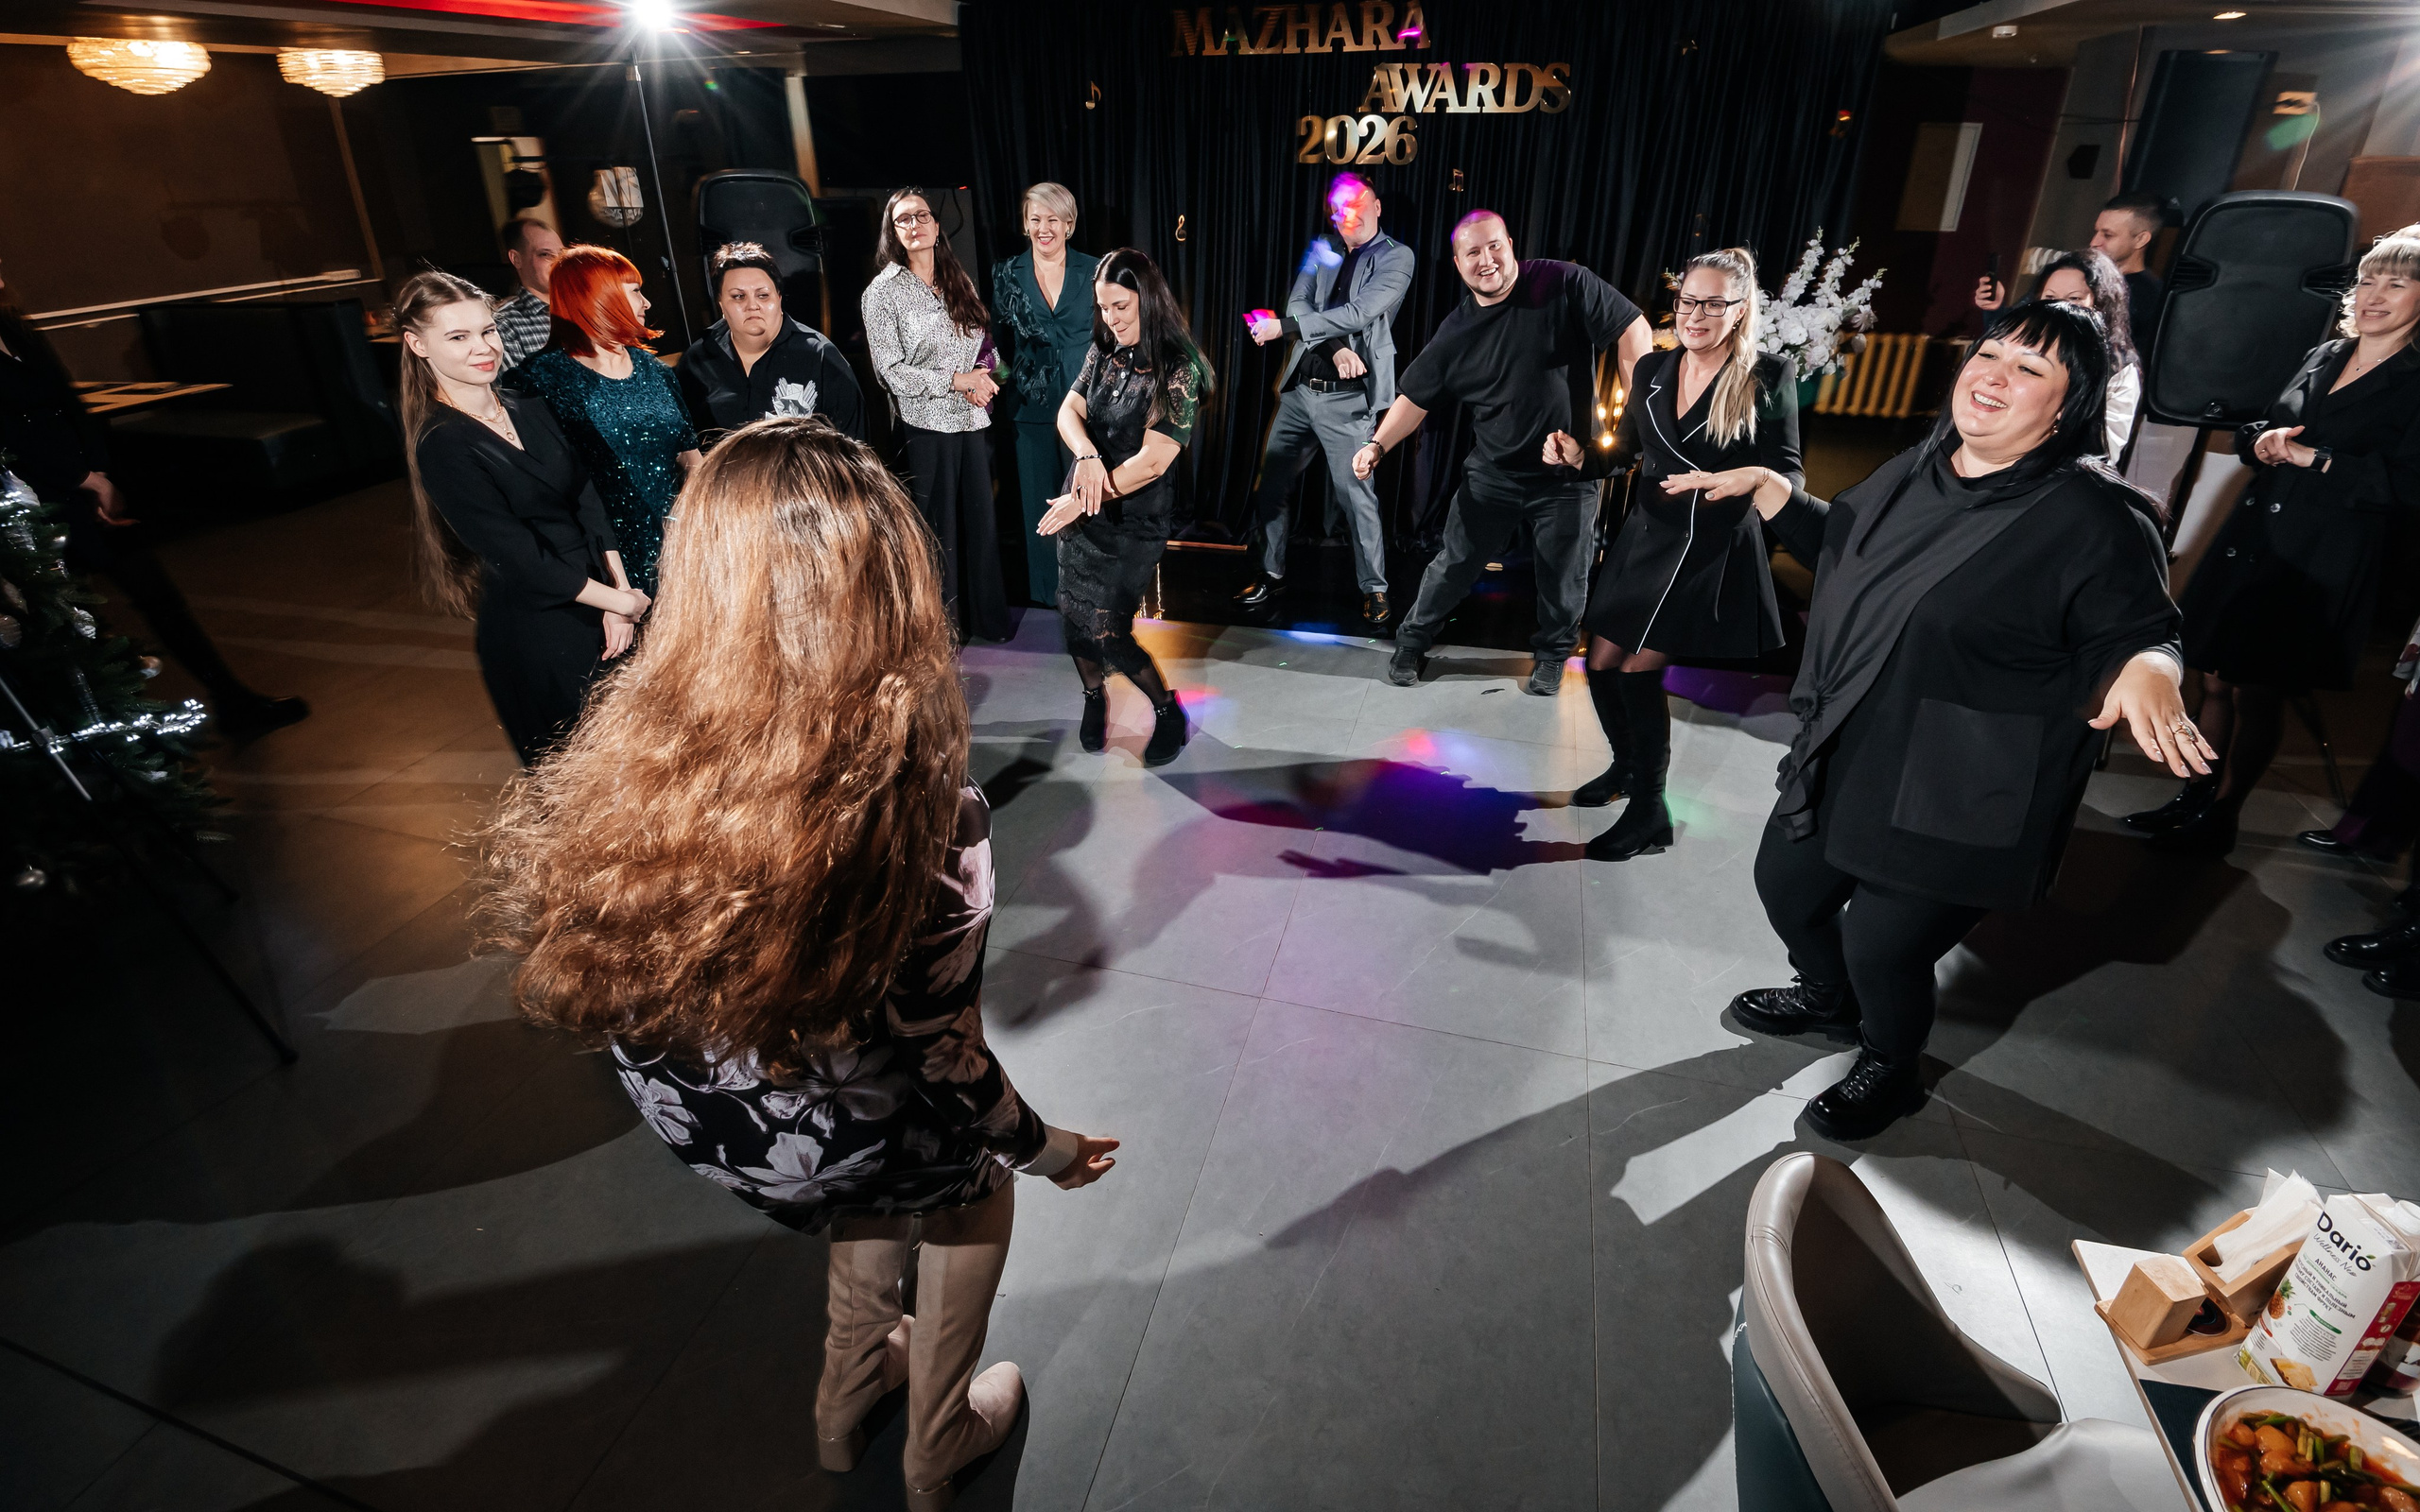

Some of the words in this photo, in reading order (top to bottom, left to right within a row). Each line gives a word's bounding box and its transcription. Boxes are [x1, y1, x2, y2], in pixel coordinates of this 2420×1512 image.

[1170, 0, 1430, 57] MAZHARA
[1356, 61, 1571, 113] AWARDS
[1297, 114, 1418, 165] 2026
[2313, 1232, 2342, 1263] Wellness
[2314, 1258, 2337, 1281] АНАНАС
[2316, 1280, 2348, 1309] УНИКАЛЬНЫЙ
[2317, 1296, 2332, 1311] ФРУКТ
[2325, 1297, 2356, 1318] ПОЛЕЗНЫМ
